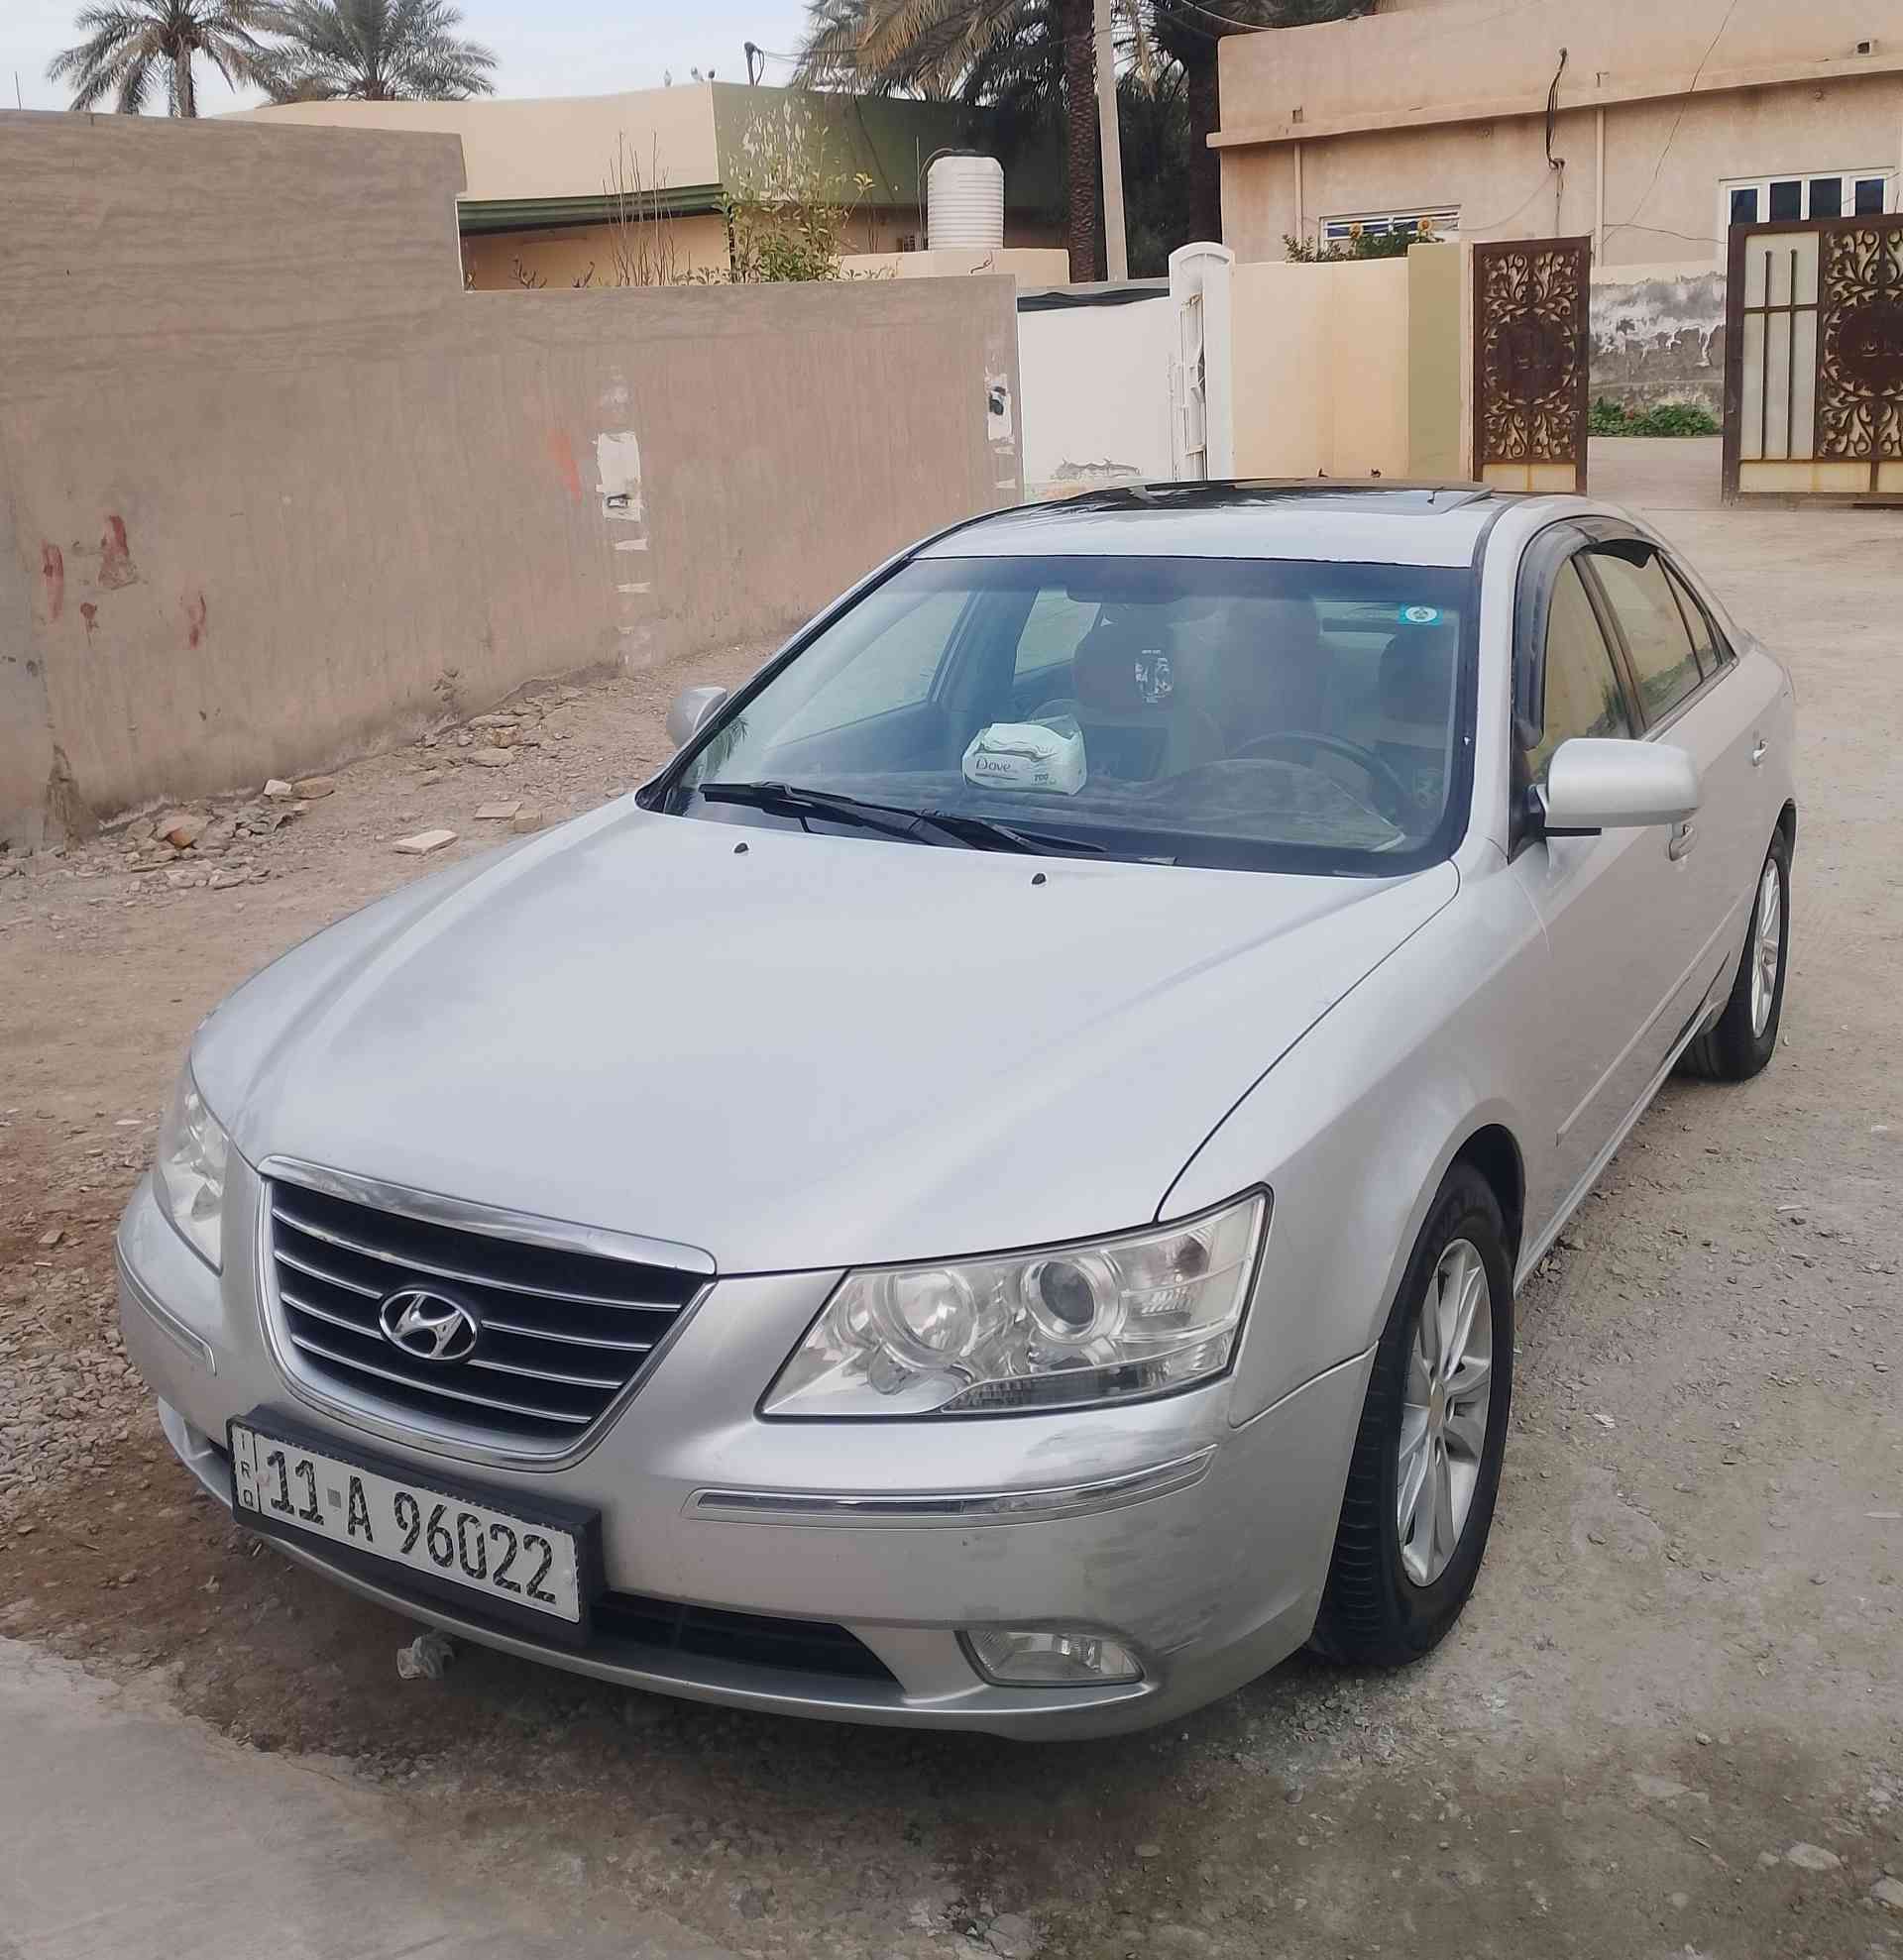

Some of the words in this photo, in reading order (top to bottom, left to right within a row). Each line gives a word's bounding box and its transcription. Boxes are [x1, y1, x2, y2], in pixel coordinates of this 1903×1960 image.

[975, 758, 1010, 771] Dove
[240, 1434, 255, 1506] IRQ
[267, 1450, 324, 1525] 11
[347, 1474, 374, 1543] A
[393, 1491, 556, 1604] 96022
